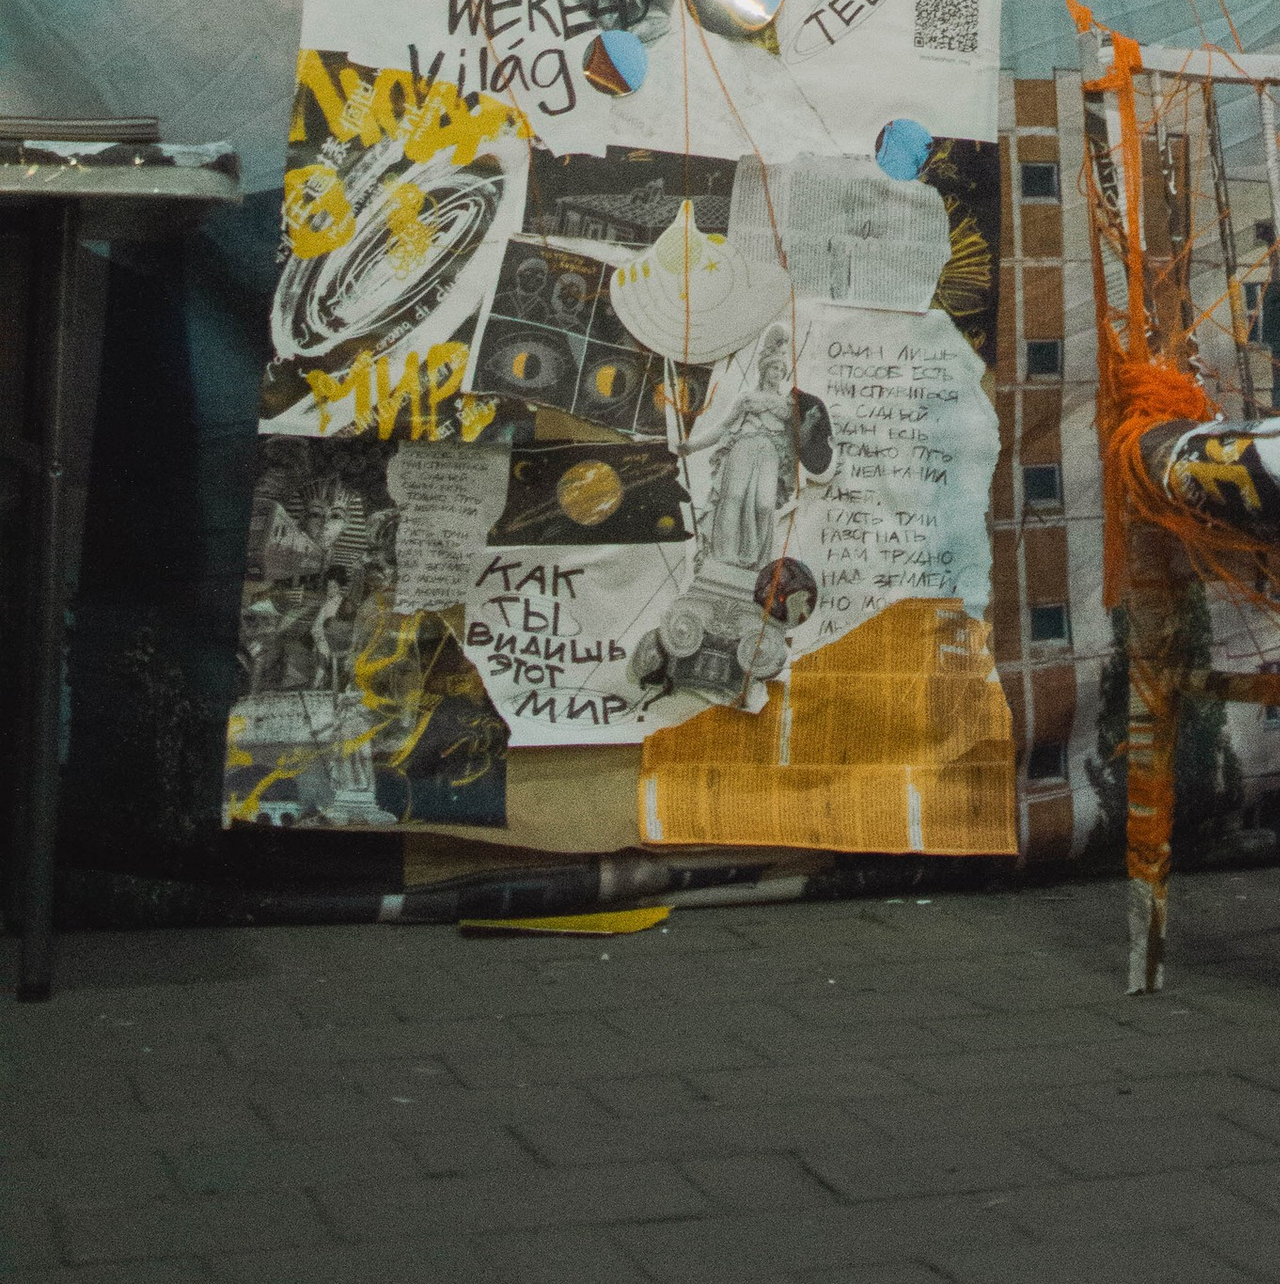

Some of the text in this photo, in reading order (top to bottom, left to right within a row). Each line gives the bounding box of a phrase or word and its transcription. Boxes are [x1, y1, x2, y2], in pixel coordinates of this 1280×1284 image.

[408, 37, 577, 117] Világ
[475, 555, 585, 599] КАК
[487, 596, 561, 637] ТЫ
[466, 621, 627, 664] ВИДИШЬ
[487, 653, 566, 689] ЭТОТ
